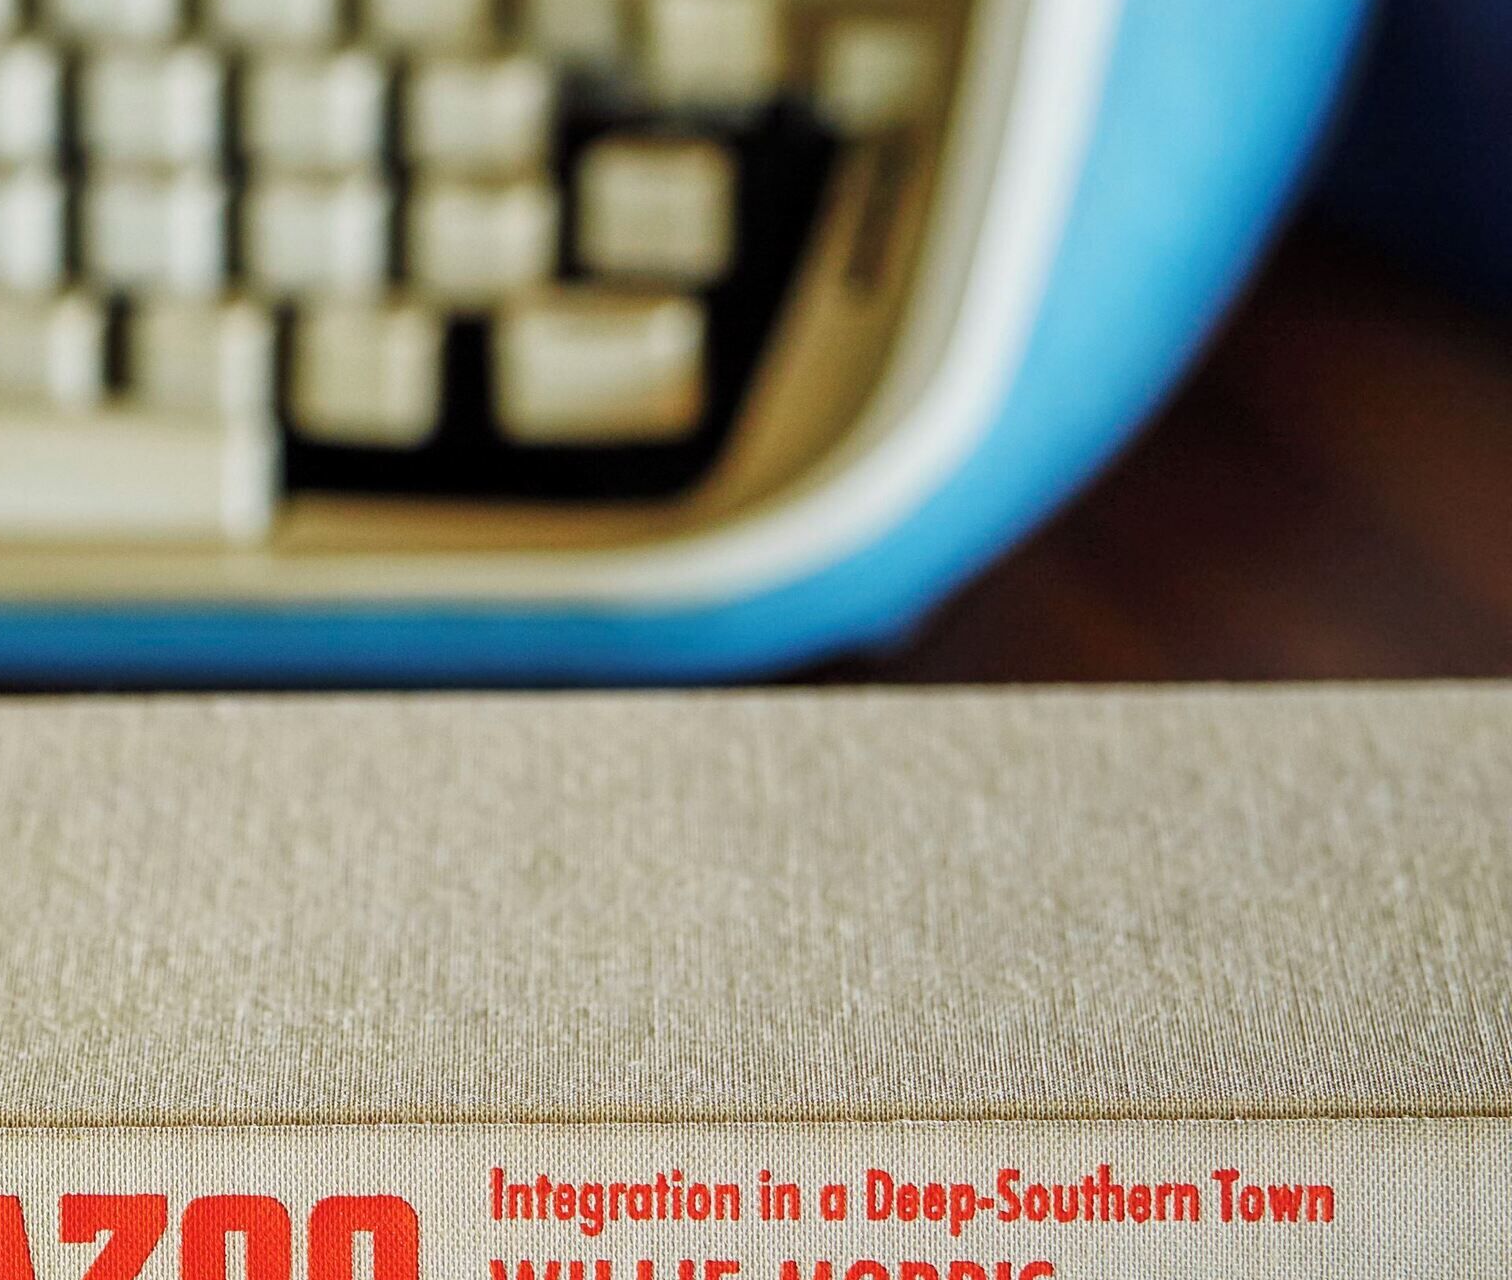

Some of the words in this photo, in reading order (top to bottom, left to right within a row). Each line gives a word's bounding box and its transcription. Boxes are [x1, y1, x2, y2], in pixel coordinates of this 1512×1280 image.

[490, 1167, 740, 1237] Integration
[758, 1169, 801, 1221] in
[820, 1183, 847, 1221] a
[866, 1164, 1200, 1237] Deep-Southern
[1212, 1168, 1334, 1223] Town
